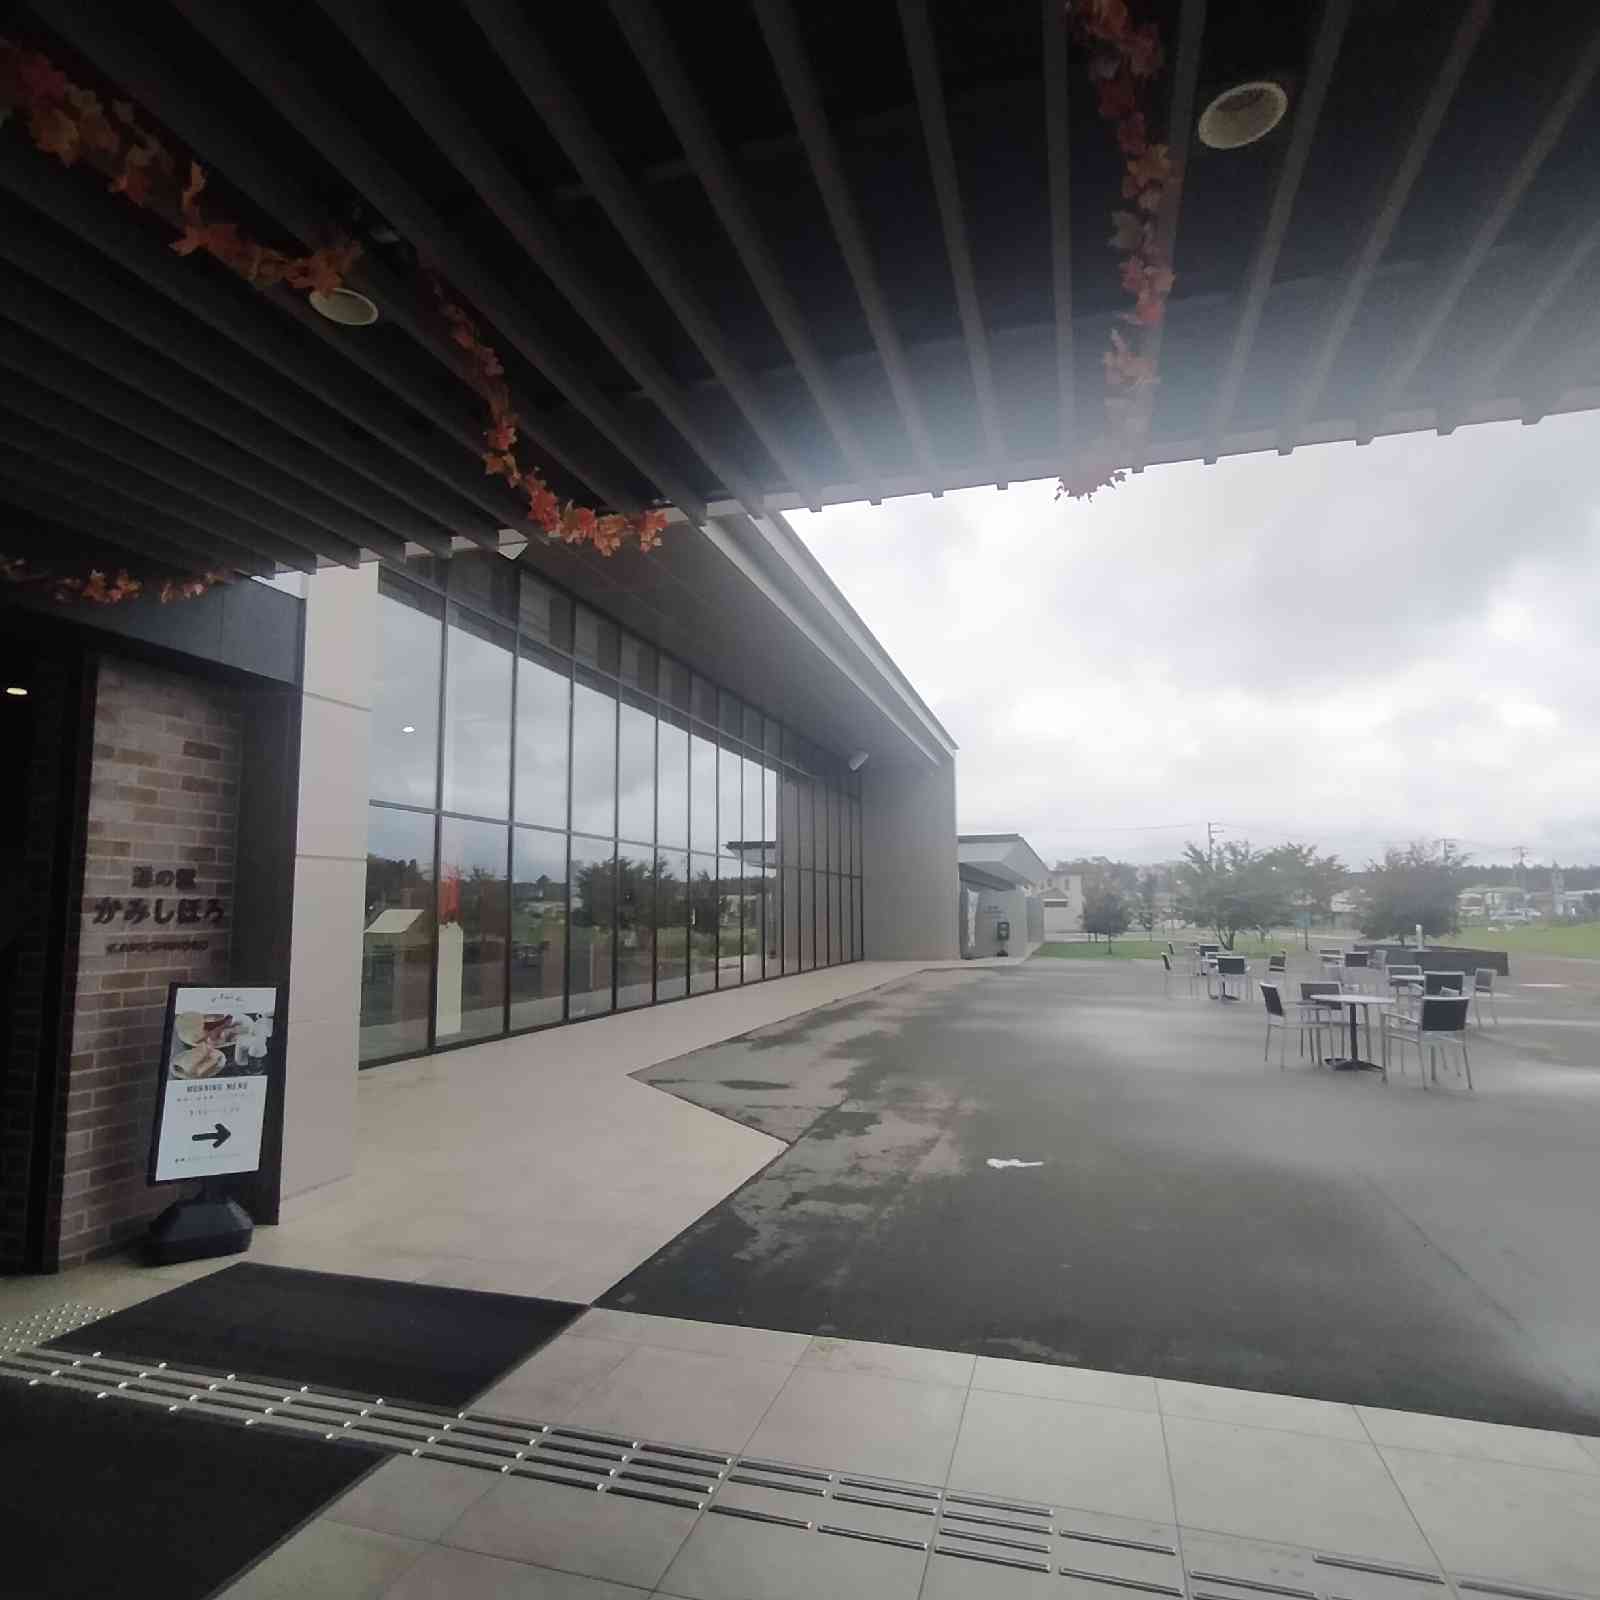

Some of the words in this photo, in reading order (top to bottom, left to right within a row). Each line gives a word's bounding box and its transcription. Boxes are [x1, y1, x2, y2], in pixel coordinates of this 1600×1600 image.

[93, 897, 224, 925] かみしほろ
